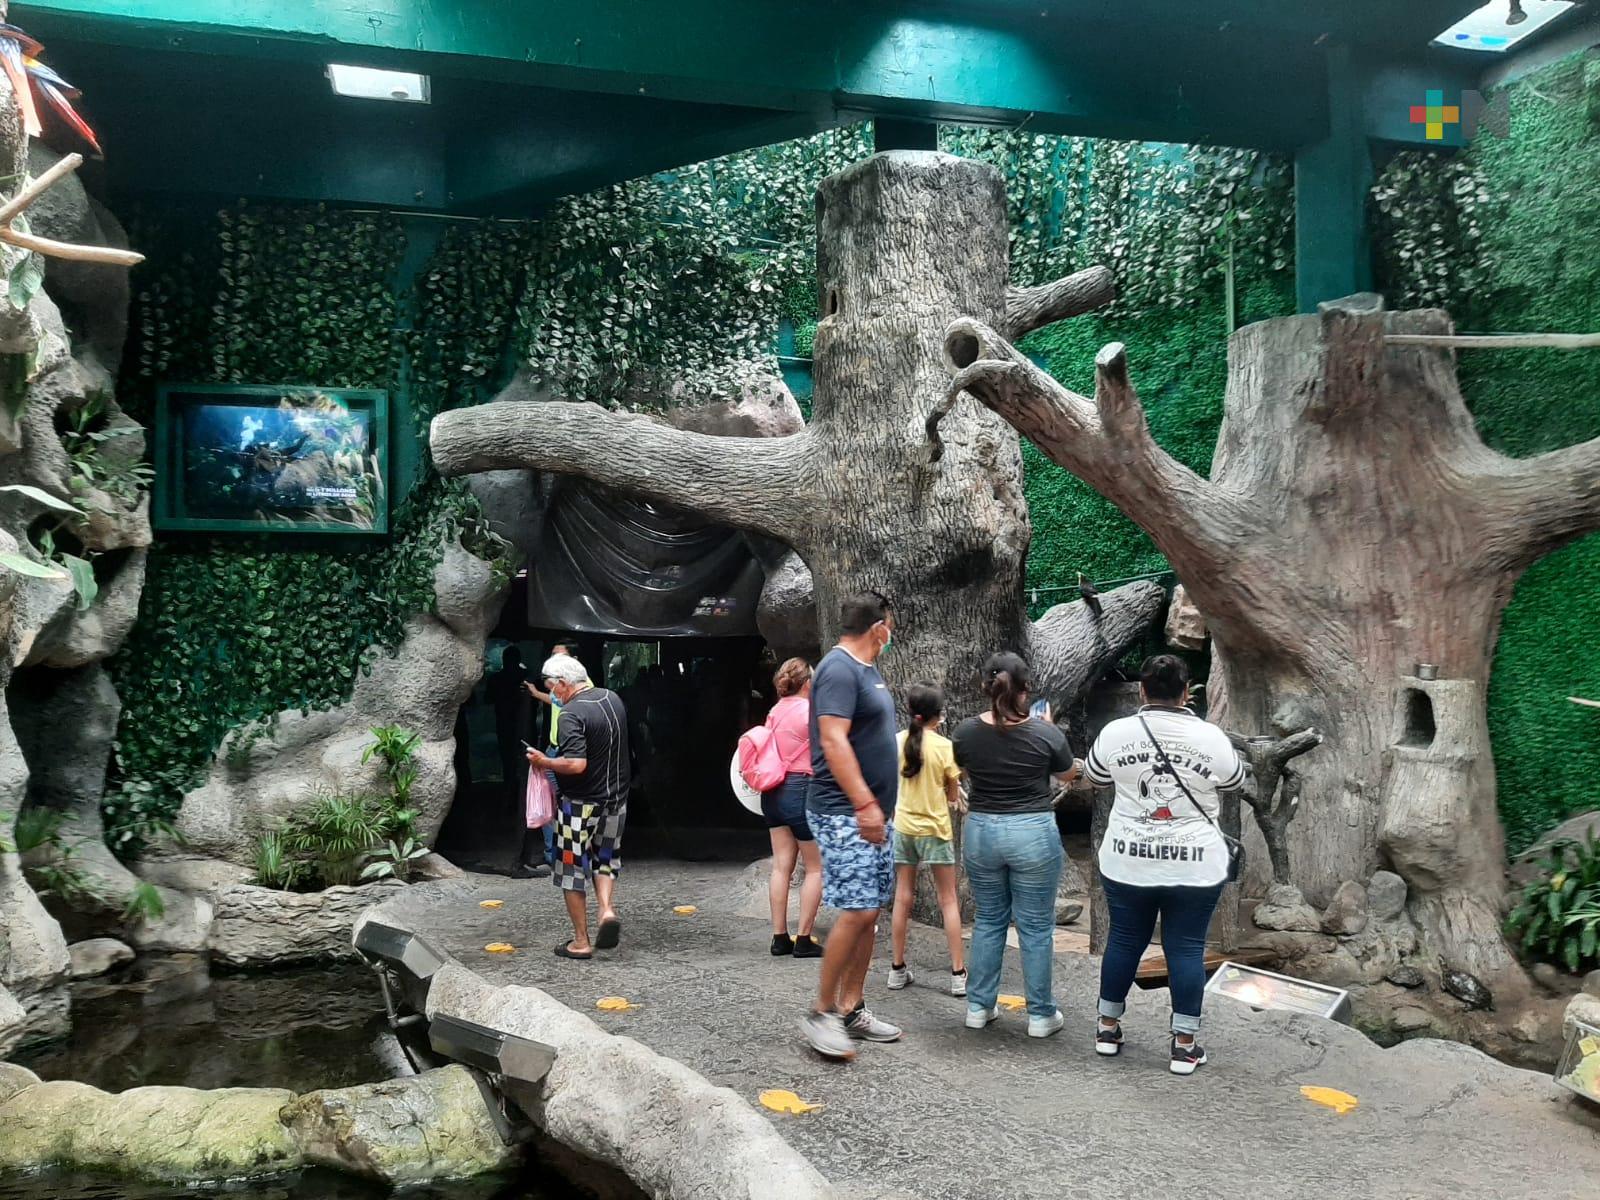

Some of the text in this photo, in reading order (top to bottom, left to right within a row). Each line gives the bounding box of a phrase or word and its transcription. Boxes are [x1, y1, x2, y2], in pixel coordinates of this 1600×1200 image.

[1121, 741, 1213, 763] MY BODY KNOWS
[1117, 752, 1212, 779] HOW OLD I AM
[1112, 838, 1205, 862] TO BELIEVE IT
